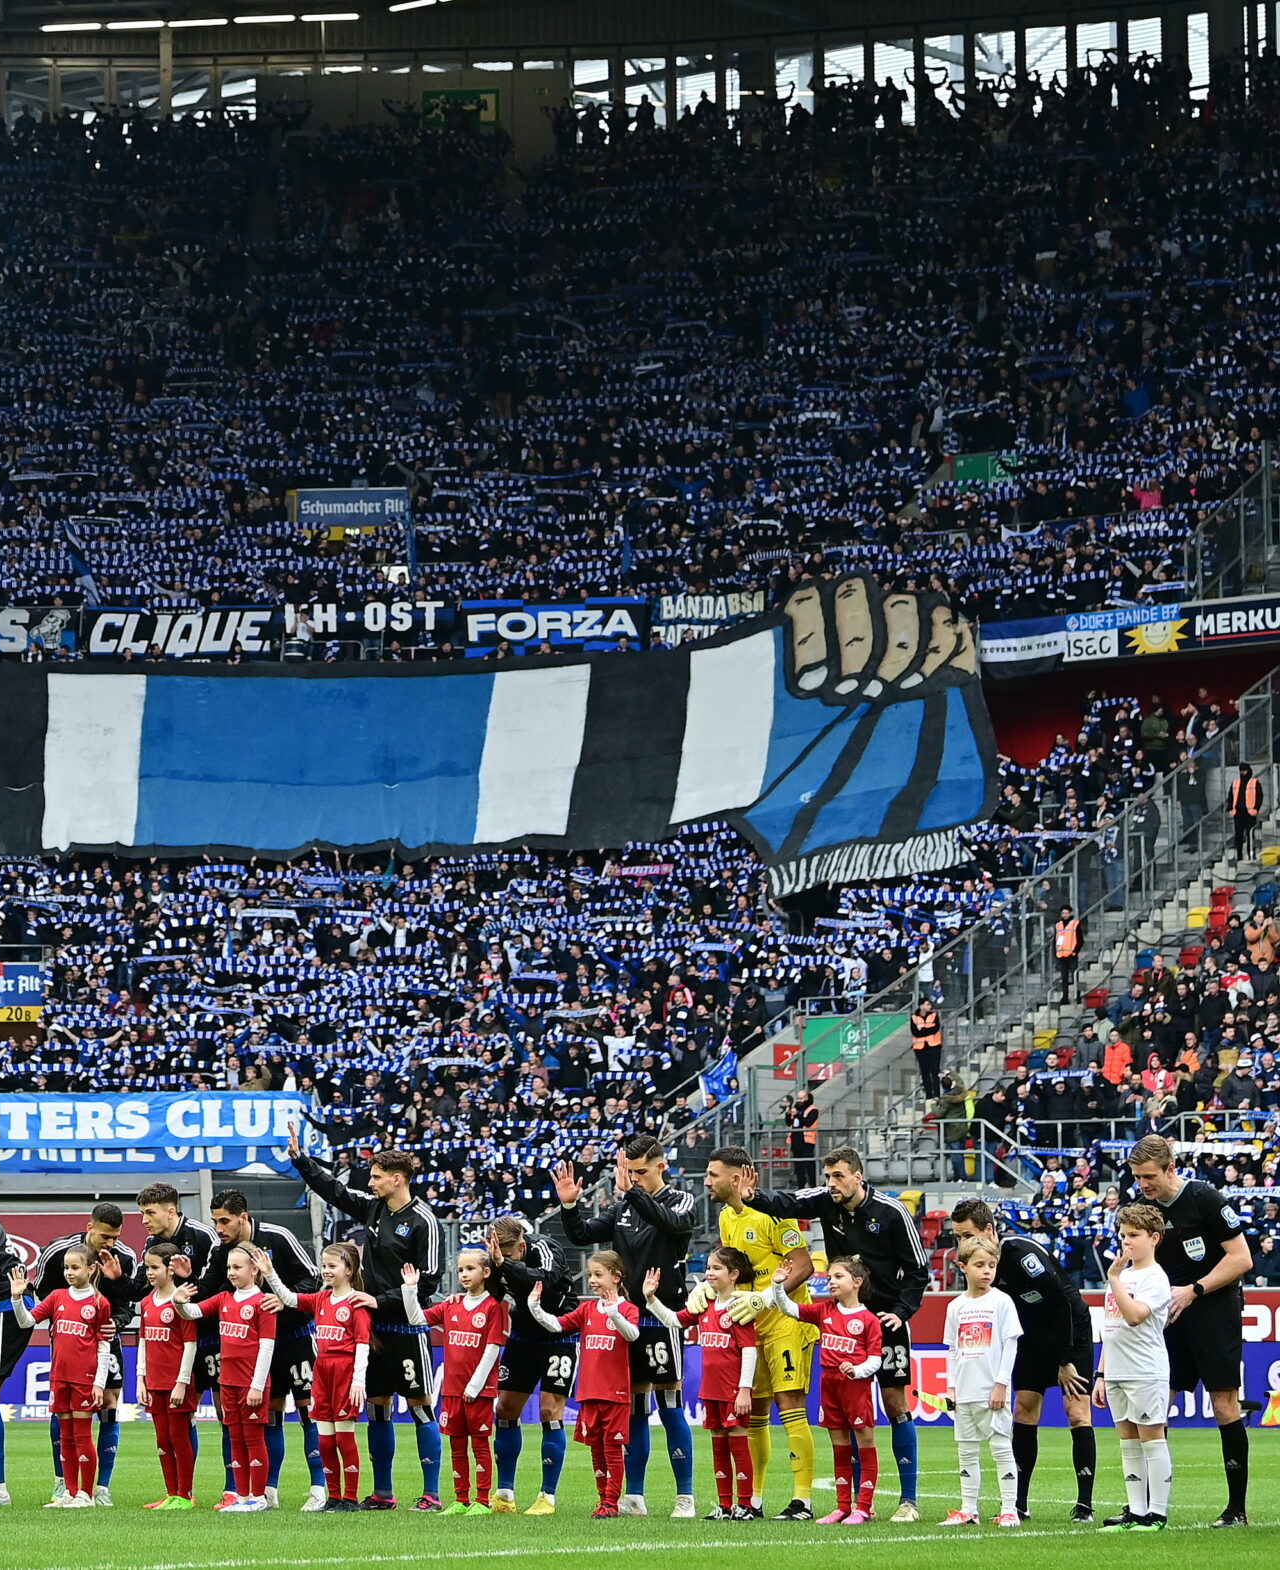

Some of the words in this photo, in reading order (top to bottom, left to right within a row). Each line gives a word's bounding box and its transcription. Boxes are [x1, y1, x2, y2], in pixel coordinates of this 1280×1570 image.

[300, 499, 382, 517] Schumacher
[384, 498, 405, 516] Alt
[363, 601, 445, 632] OST
[467, 609, 639, 642] FORZA
[17, 974, 40, 995] Alt
[783, 1233, 798, 1245] popp
[1185, 1239, 1203, 1248] FIFA
[56, 1320, 89, 1337] TUFFI
[219, 1321, 250, 1338] TUFFI
[316, 1324, 346, 1341] TUFFI
[448, 1330, 482, 1347] TUFFI
[585, 1334, 616, 1351] TUFFI
[700, 1331, 732, 1349] TUFFI
[821, 1333, 858, 1354] TUFFI
[645, 1341, 670, 1368] 16
[781, 1349, 795, 1372] 1
[882, 1345, 908, 1370] 23
[402, 1358, 416, 1381] 3
[548, 1354, 571, 1378] 28
